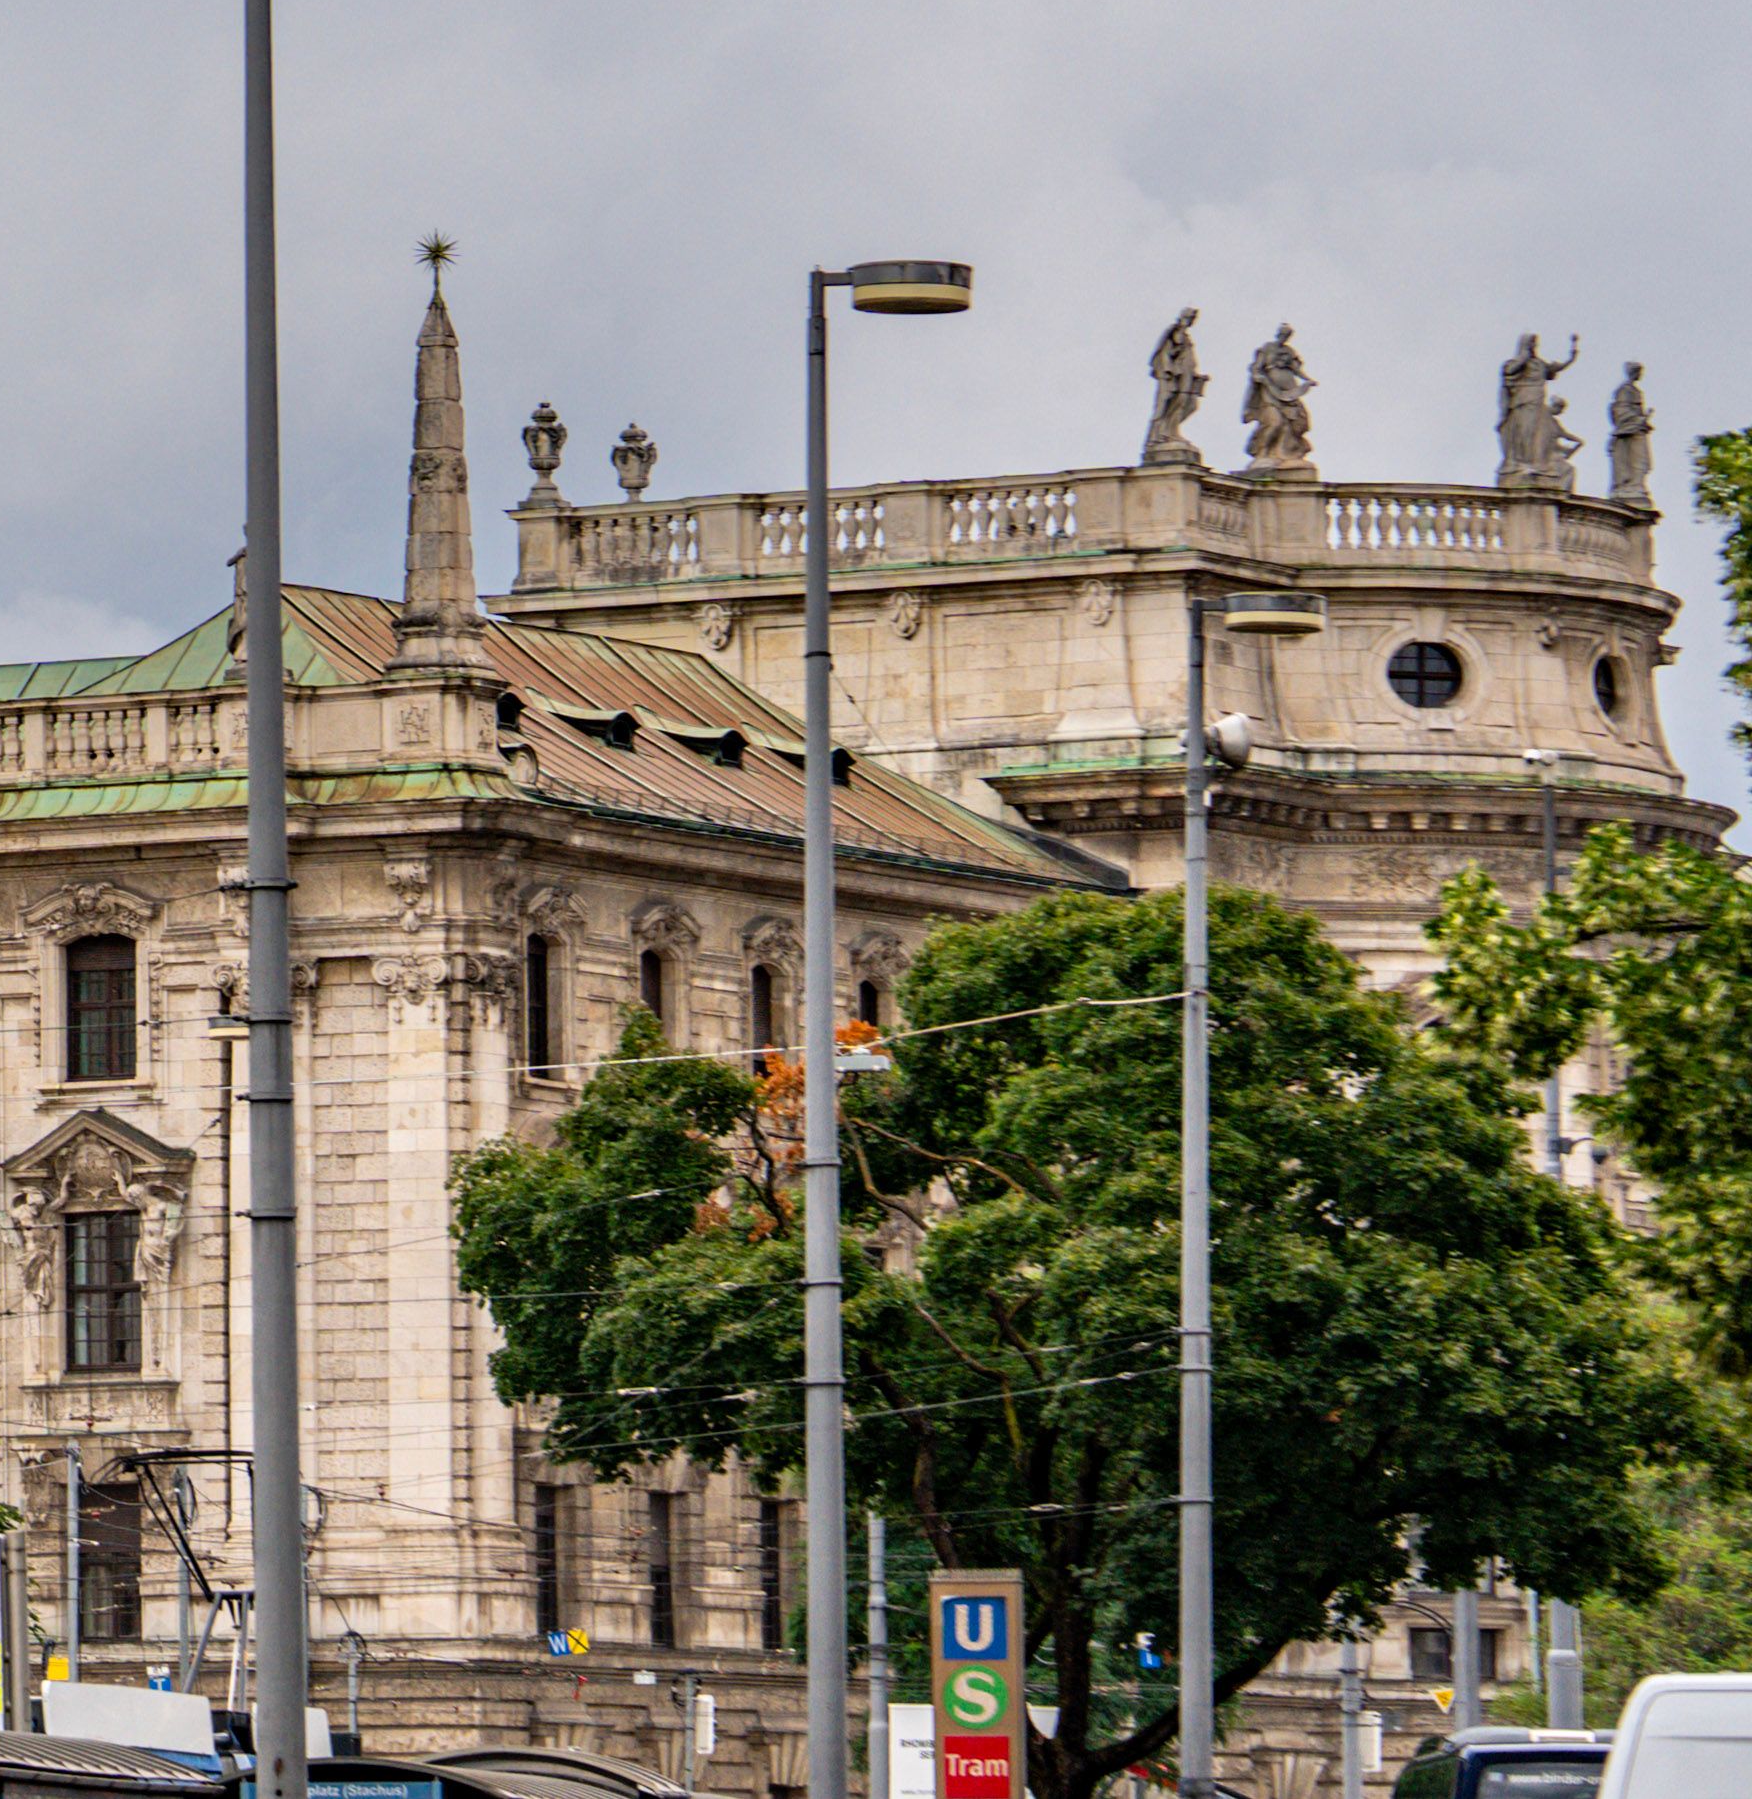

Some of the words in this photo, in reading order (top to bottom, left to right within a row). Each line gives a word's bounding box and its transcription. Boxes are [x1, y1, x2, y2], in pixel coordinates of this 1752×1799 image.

[954, 1604, 994, 1652] U
[952, 1670, 998, 1724] S
[945, 1753, 1010, 1779] Tram
[306, 1784, 340, 1798] platz
[342, 1783, 408, 1799] (Stachus)
